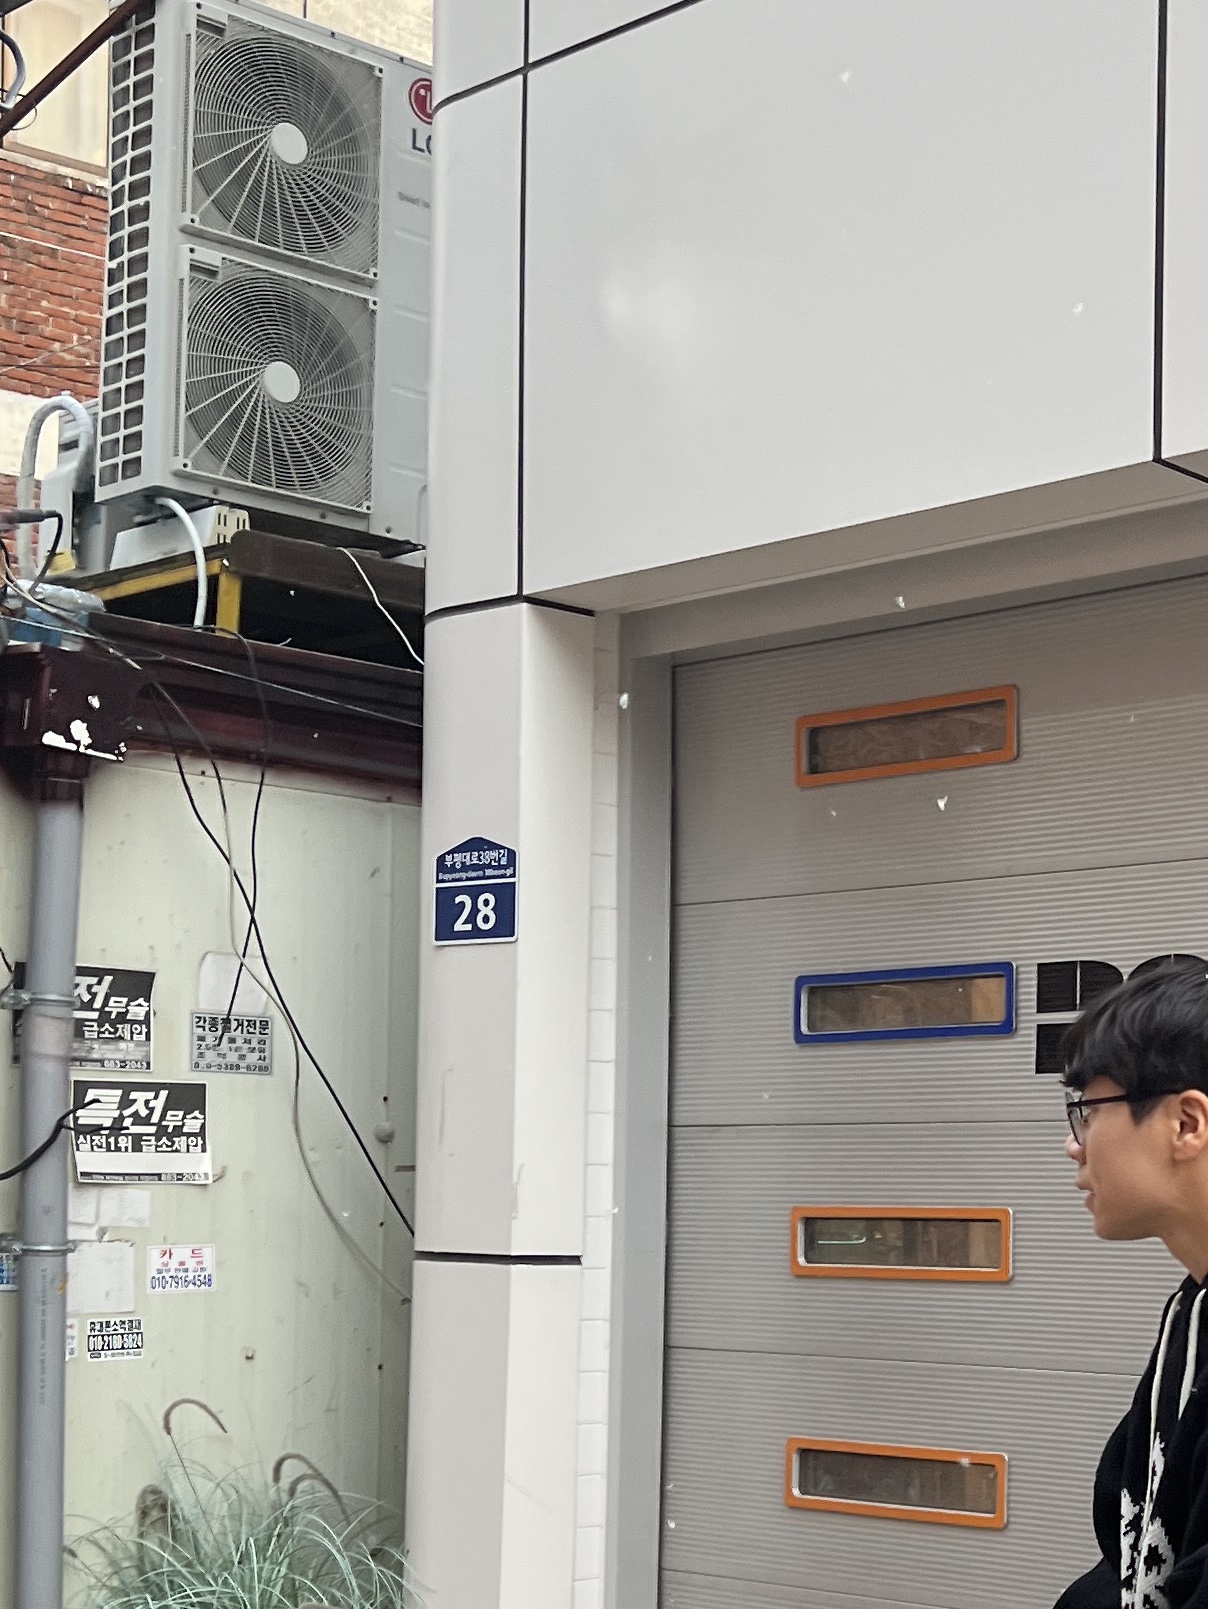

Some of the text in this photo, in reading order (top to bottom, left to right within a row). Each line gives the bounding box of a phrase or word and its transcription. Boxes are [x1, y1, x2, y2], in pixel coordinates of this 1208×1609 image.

[444, 849, 508, 869] 부평대로38번길
[453, 892, 496, 932] 28
[82, 1023, 147, 1041] 급소제압
[76, 1135, 203, 1153] 실전1위 급소제압
